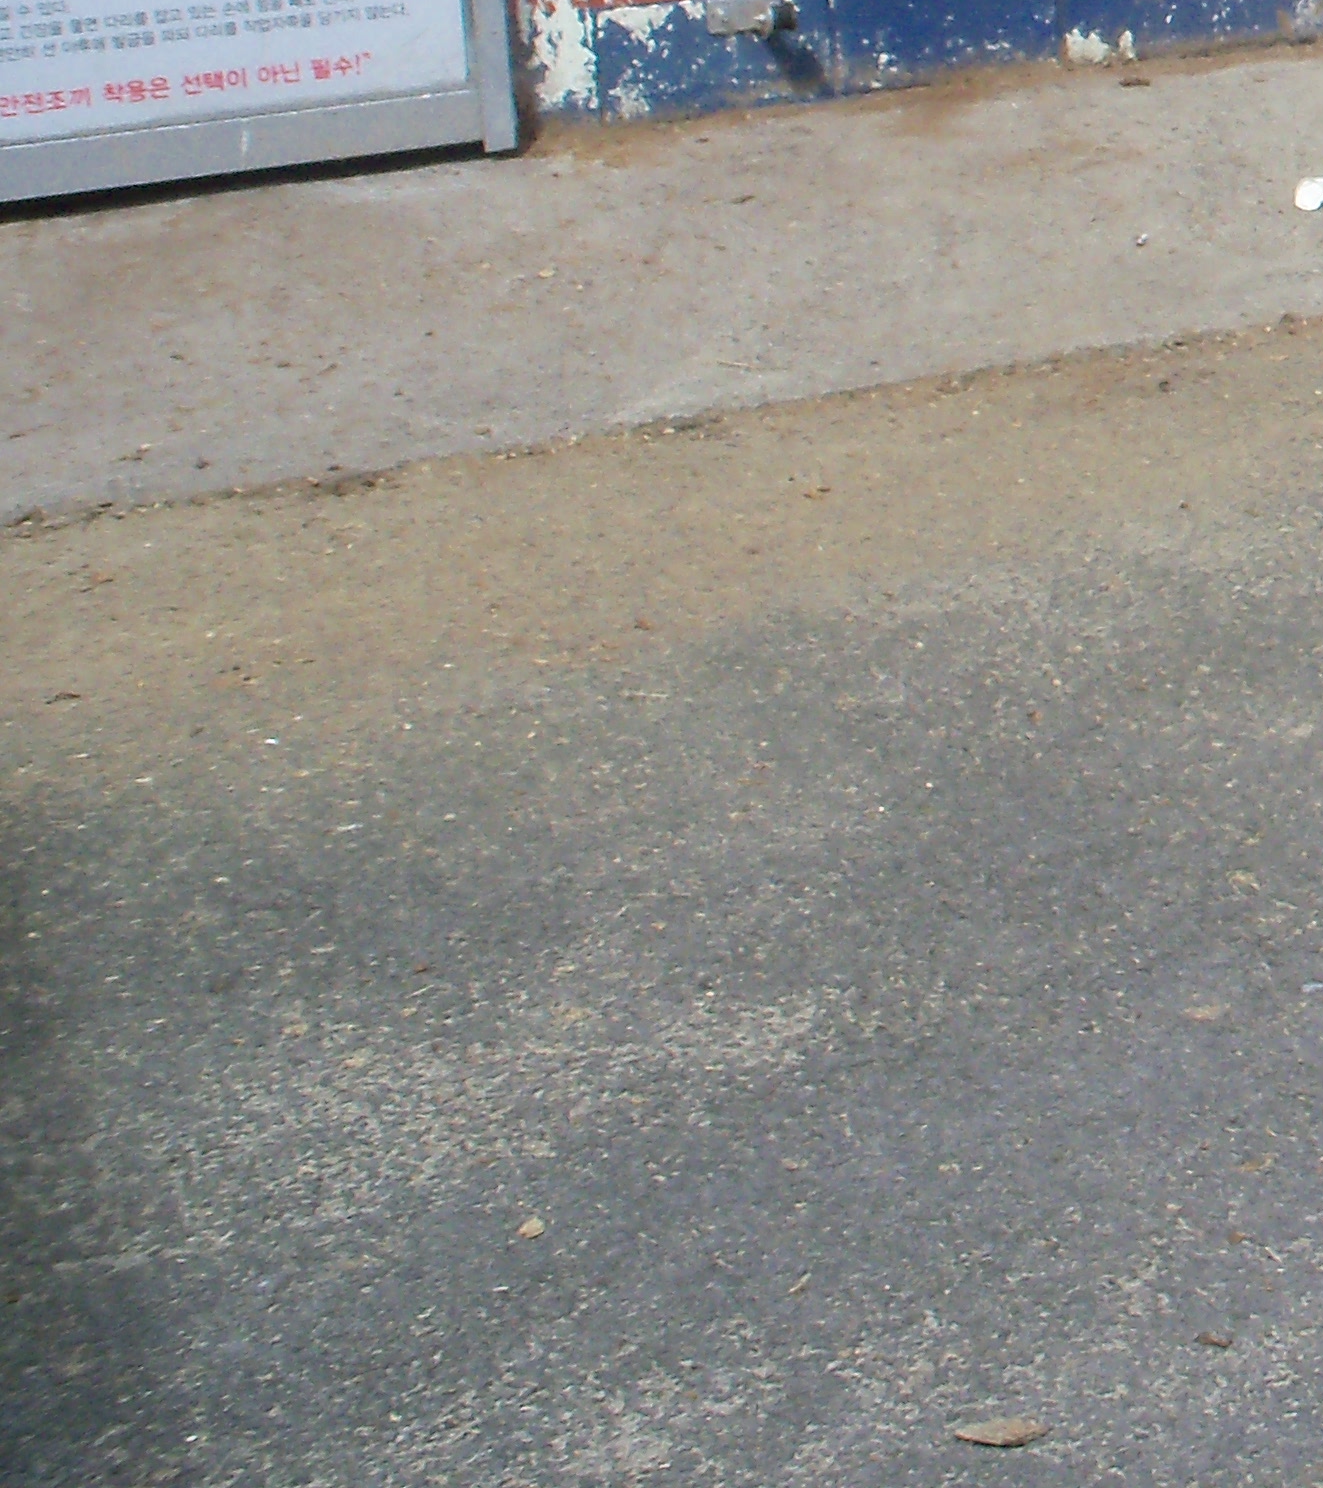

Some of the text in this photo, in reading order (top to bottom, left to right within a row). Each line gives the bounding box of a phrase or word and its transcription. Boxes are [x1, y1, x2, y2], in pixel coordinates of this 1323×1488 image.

[102, 76, 170, 106] 착용은
[181, 67, 247, 95] 선택이
[257, 62, 300, 87] 아닌
